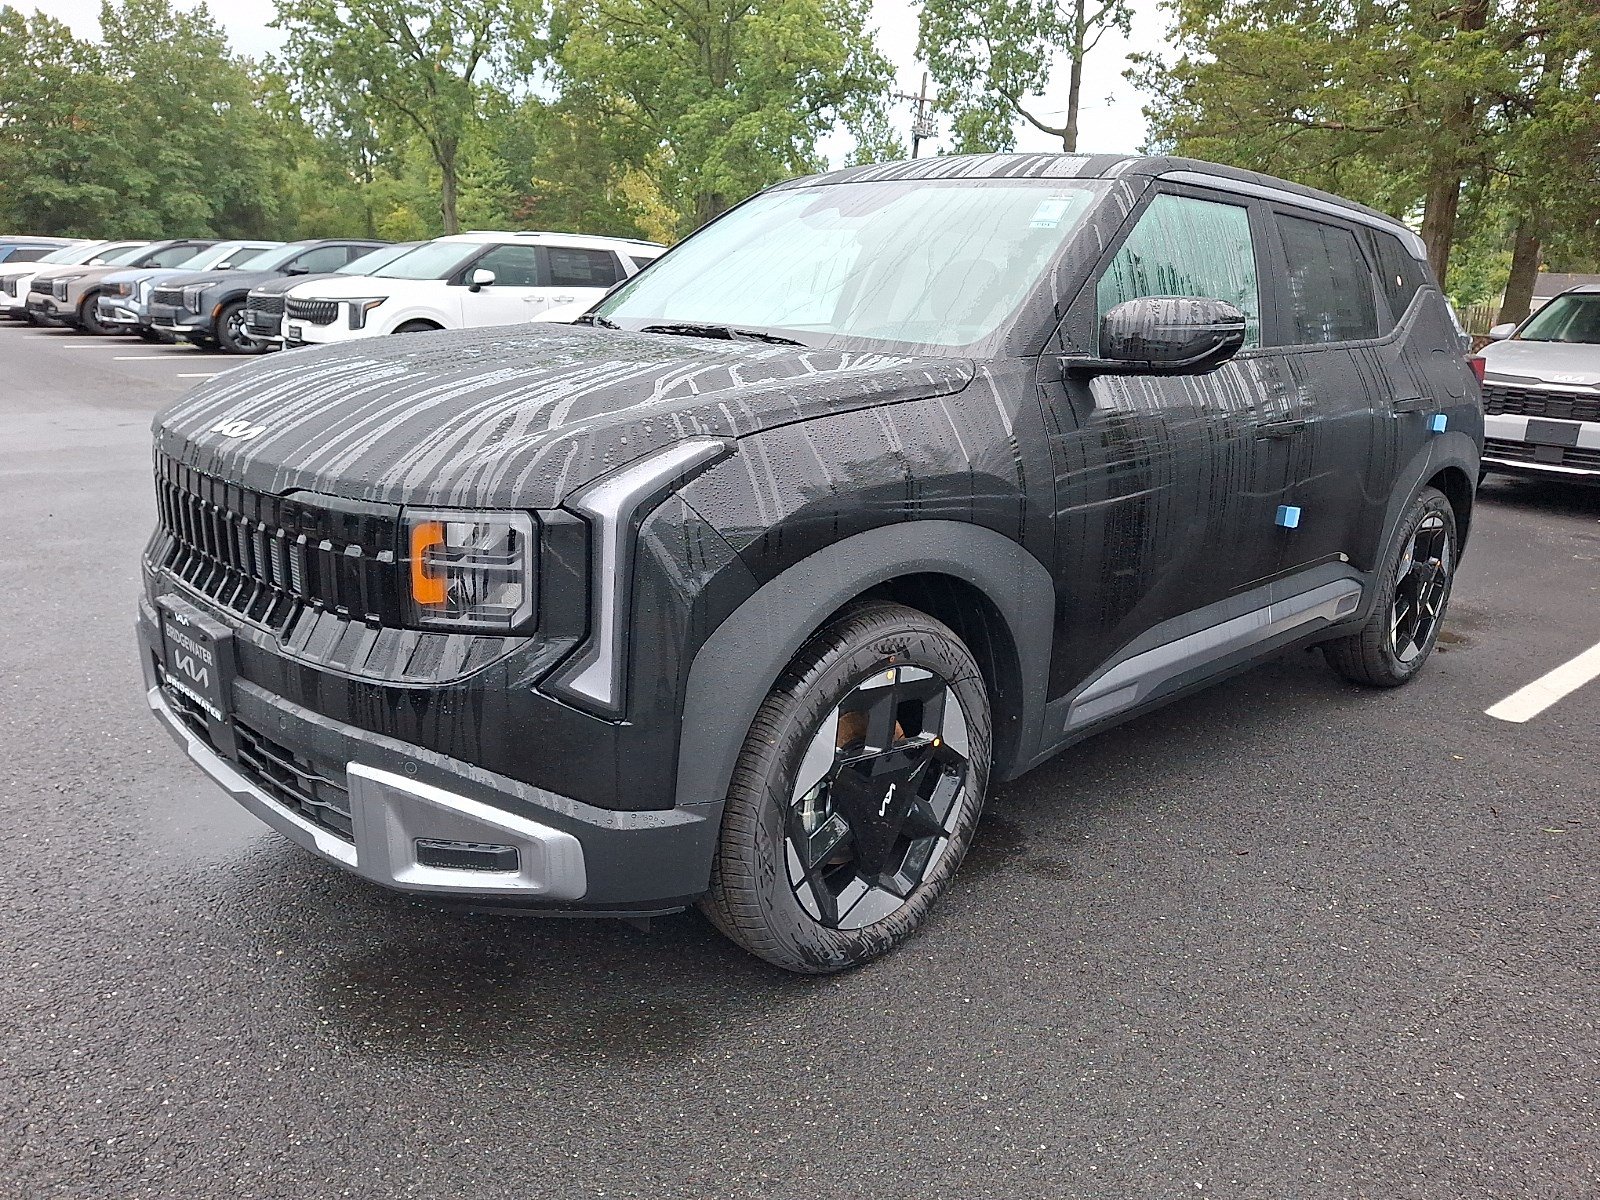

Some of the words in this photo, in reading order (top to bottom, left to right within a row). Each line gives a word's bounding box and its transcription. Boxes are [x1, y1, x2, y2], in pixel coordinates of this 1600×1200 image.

[209, 416, 267, 442] KIA
[165, 622, 213, 667] BRIDGEWATER
[174, 648, 209, 689] KIA
[165, 673, 223, 722] BRIDGEWATER
